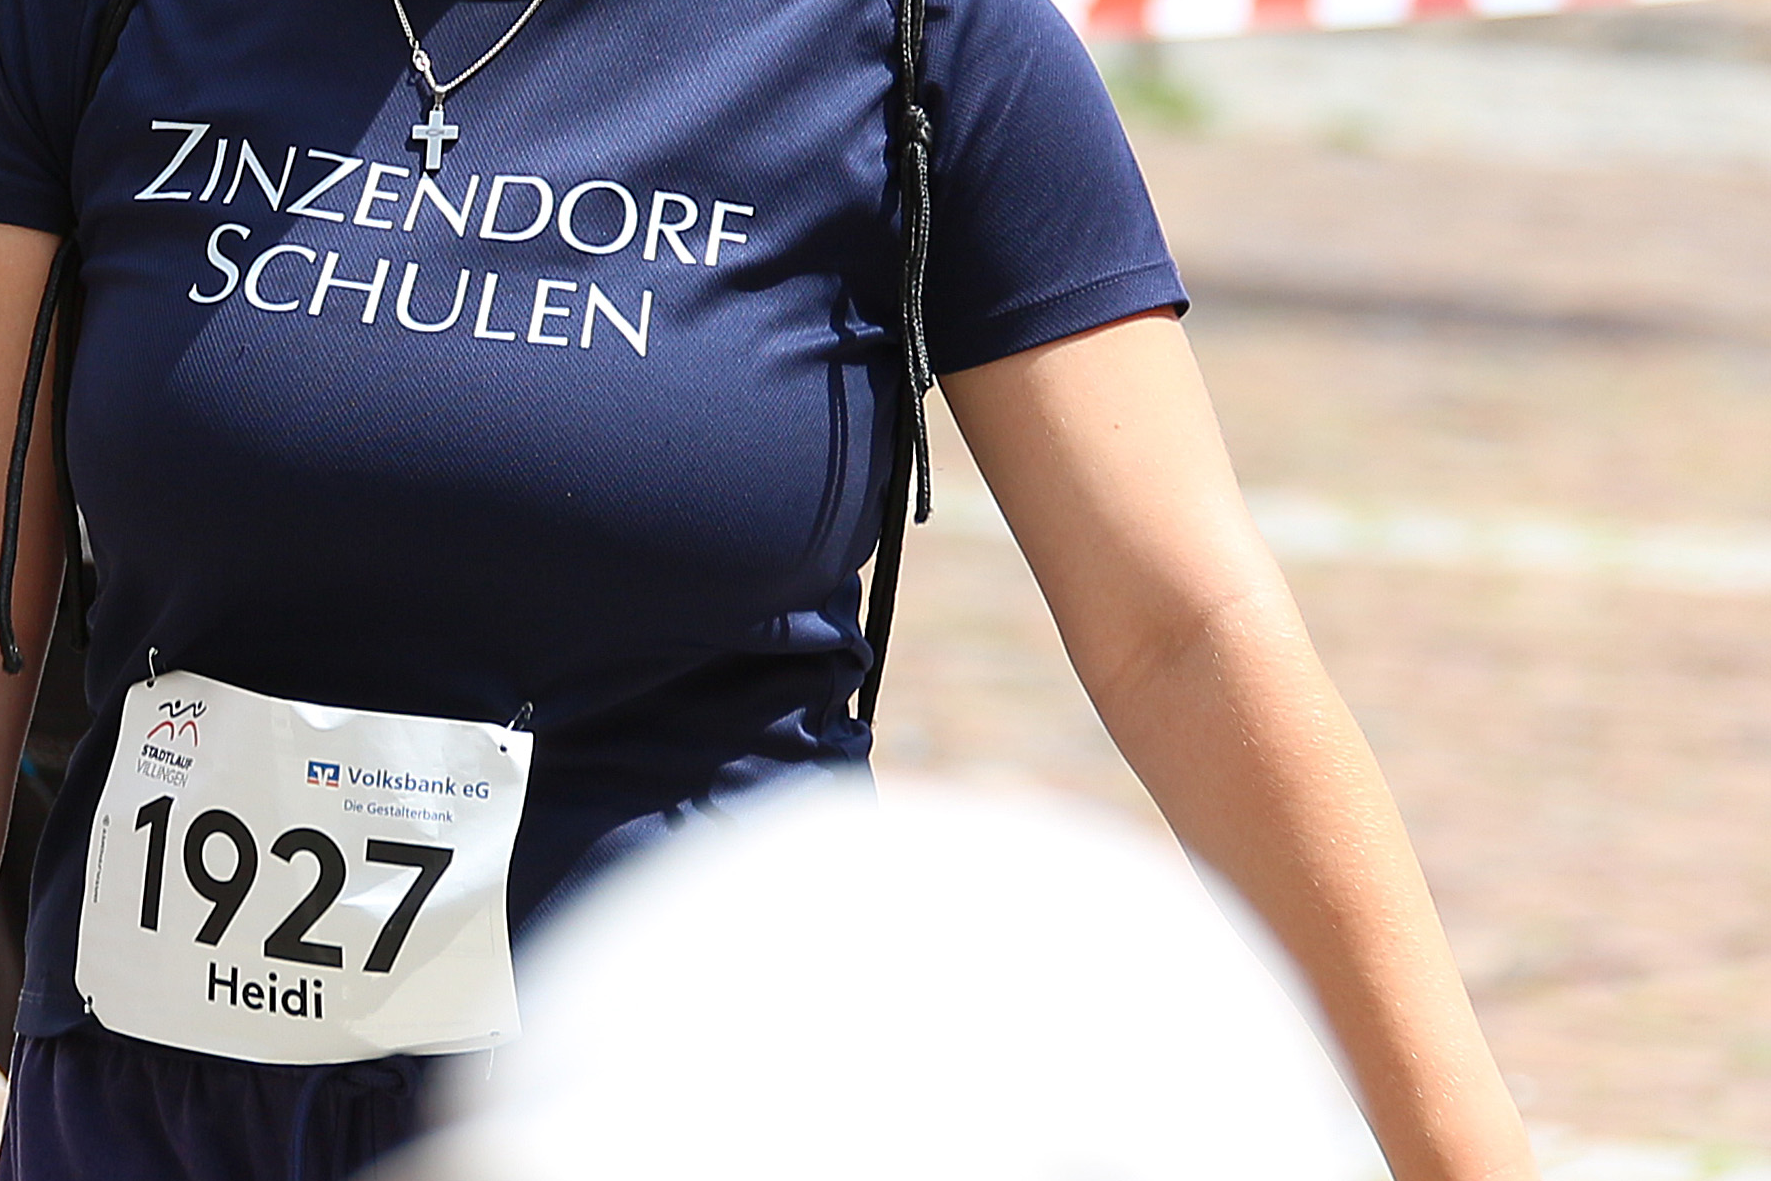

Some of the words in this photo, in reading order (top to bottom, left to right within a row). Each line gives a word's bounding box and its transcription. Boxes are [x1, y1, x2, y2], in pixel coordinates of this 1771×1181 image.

[134, 120, 755, 267] ZINZENDORF
[188, 222, 653, 357] SCHULEN
[136, 759, 188, 788] VILLINGEN
[141, 744, 193, 770] STADTLAUF
[348, 766, 456, 796] Volksbank
[463, 781, 490, 799] eG
[344, 799, 363, 813] Die
[367, 802, 453, 823] Gestalterbank
[135, 795, 455, 974] 1927
[208, 962, 324, 1019] Heidi
